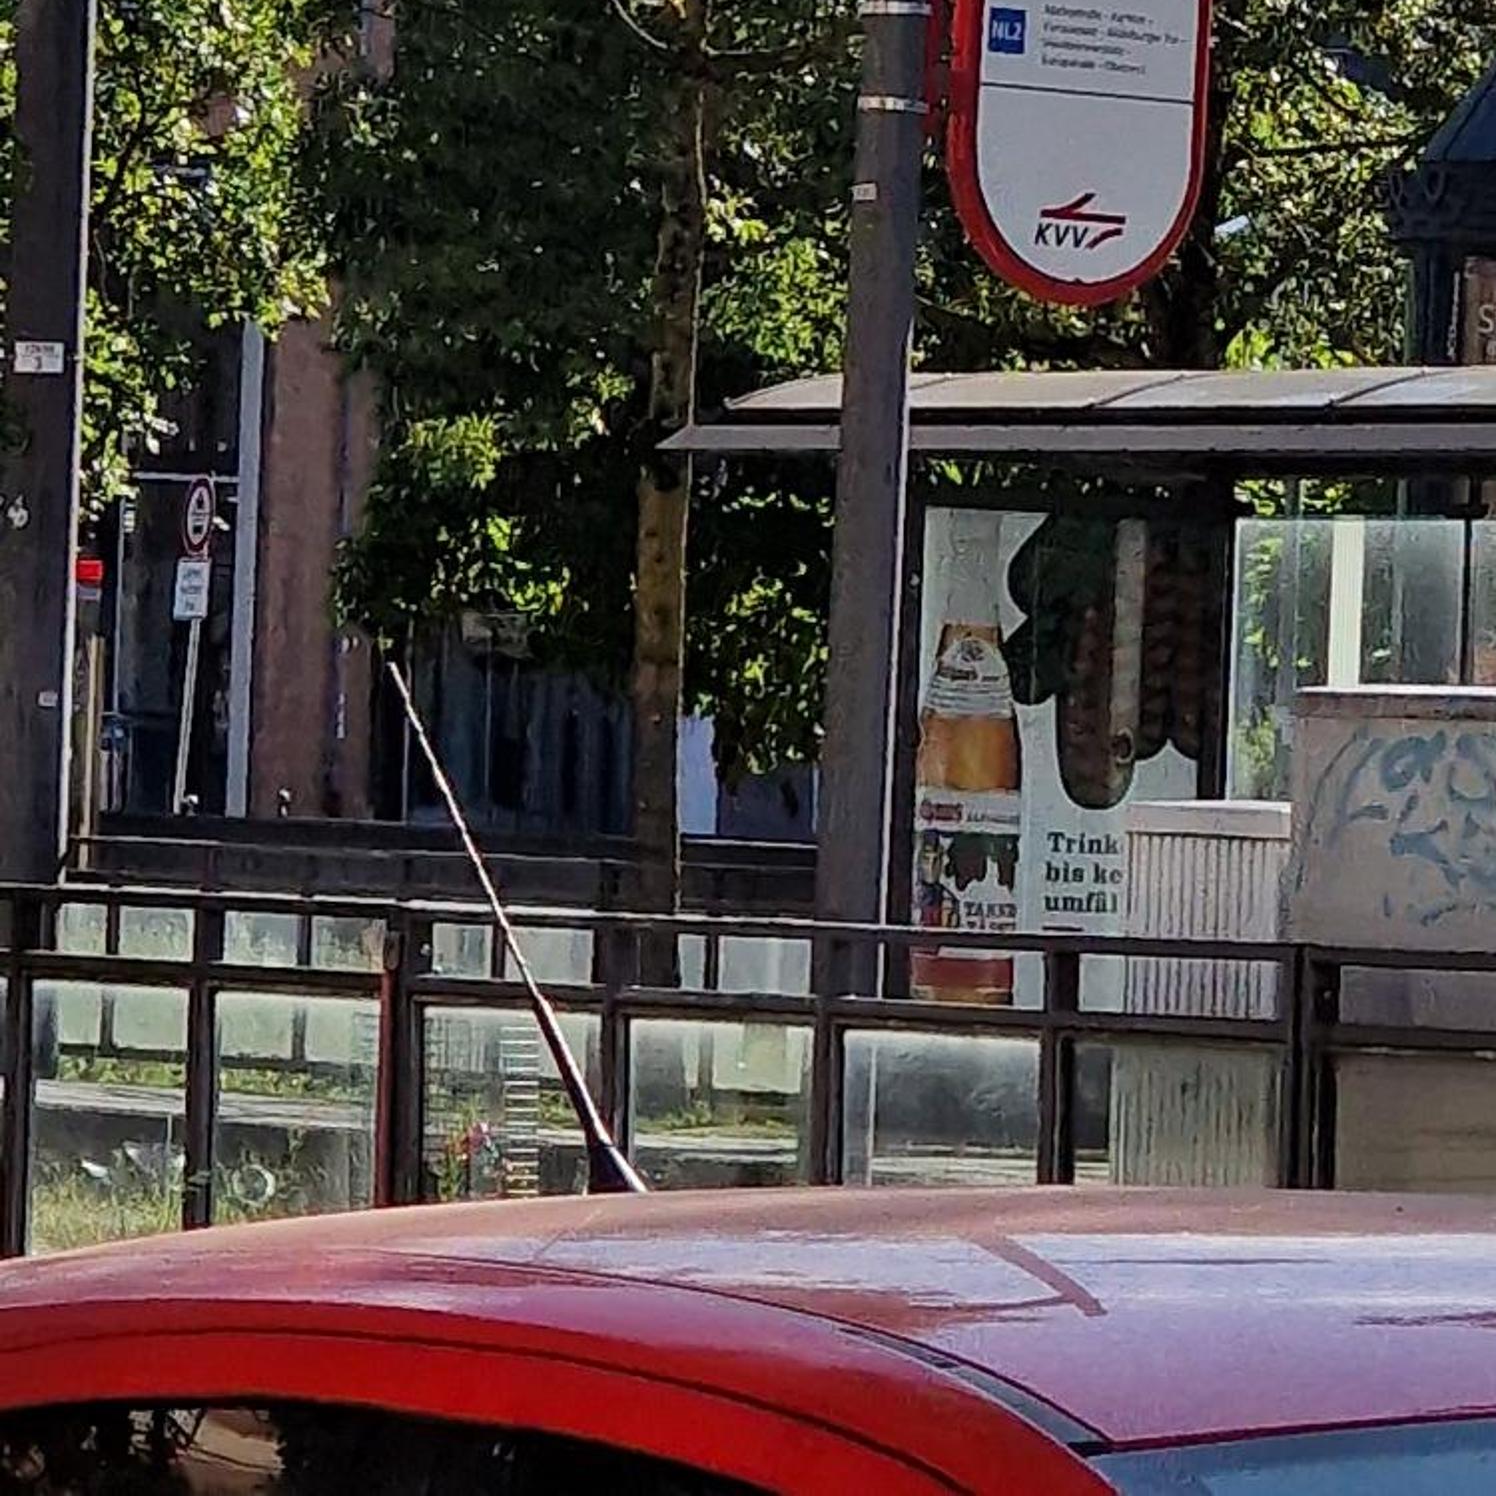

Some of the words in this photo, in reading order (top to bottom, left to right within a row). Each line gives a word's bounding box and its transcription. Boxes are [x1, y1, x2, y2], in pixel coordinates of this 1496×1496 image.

[991, 20, 1022, 41] NL2
[1034, 222, 1089, 248] KVV
[1046, 831, 1123, 854] Trink
[1045, 860, 1085, 882] bis
